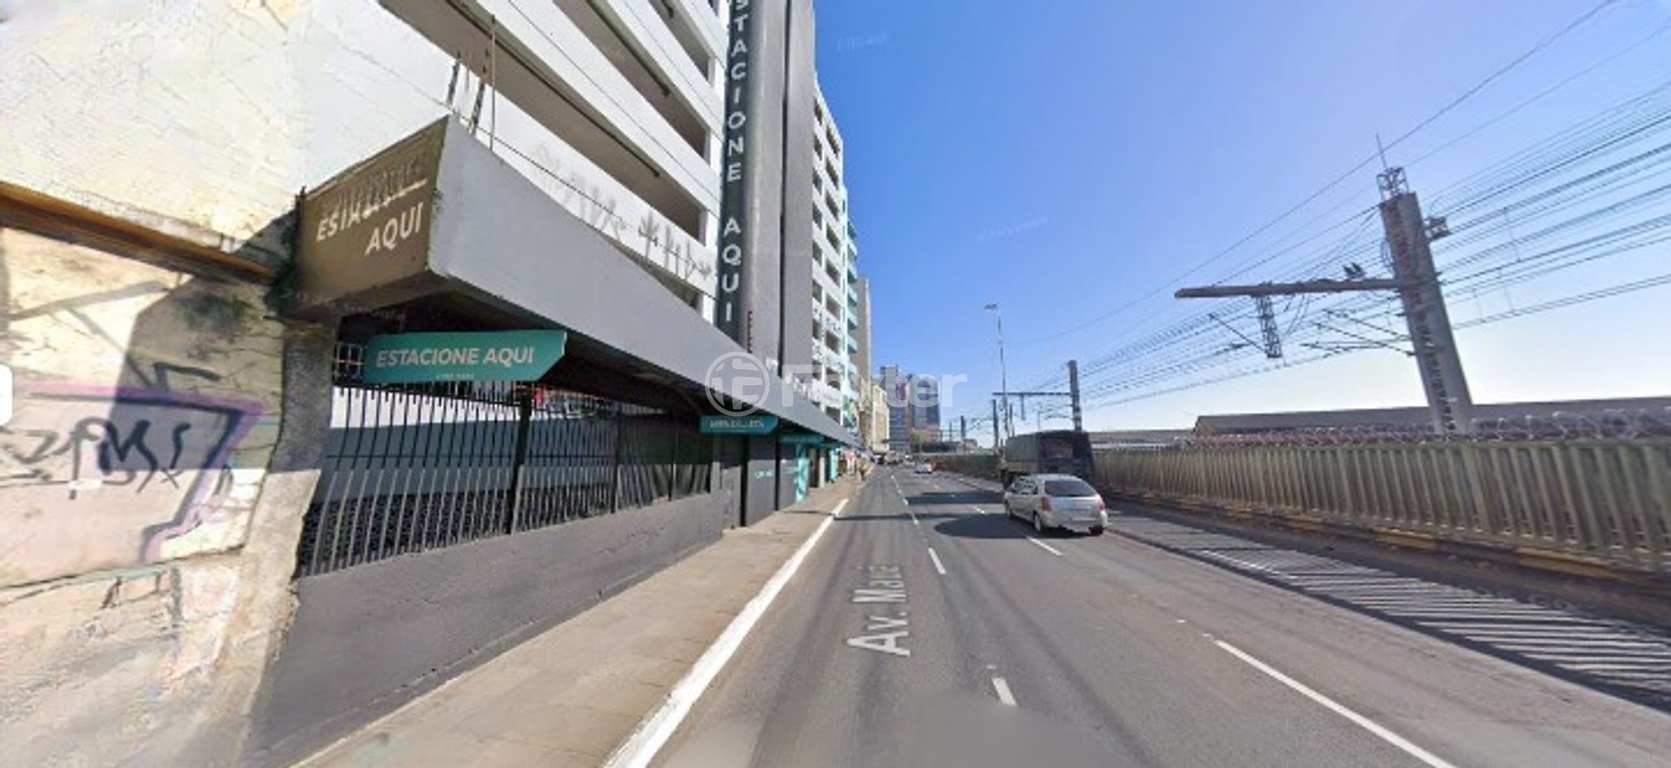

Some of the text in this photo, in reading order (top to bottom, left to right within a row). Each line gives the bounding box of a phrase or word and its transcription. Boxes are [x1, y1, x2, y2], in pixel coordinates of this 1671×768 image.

[365, 201, 424, 256] AQUI
[722, 216, 742, 322] AQUI
[376, 346, 536, 368] ESTACIONE AQUI
